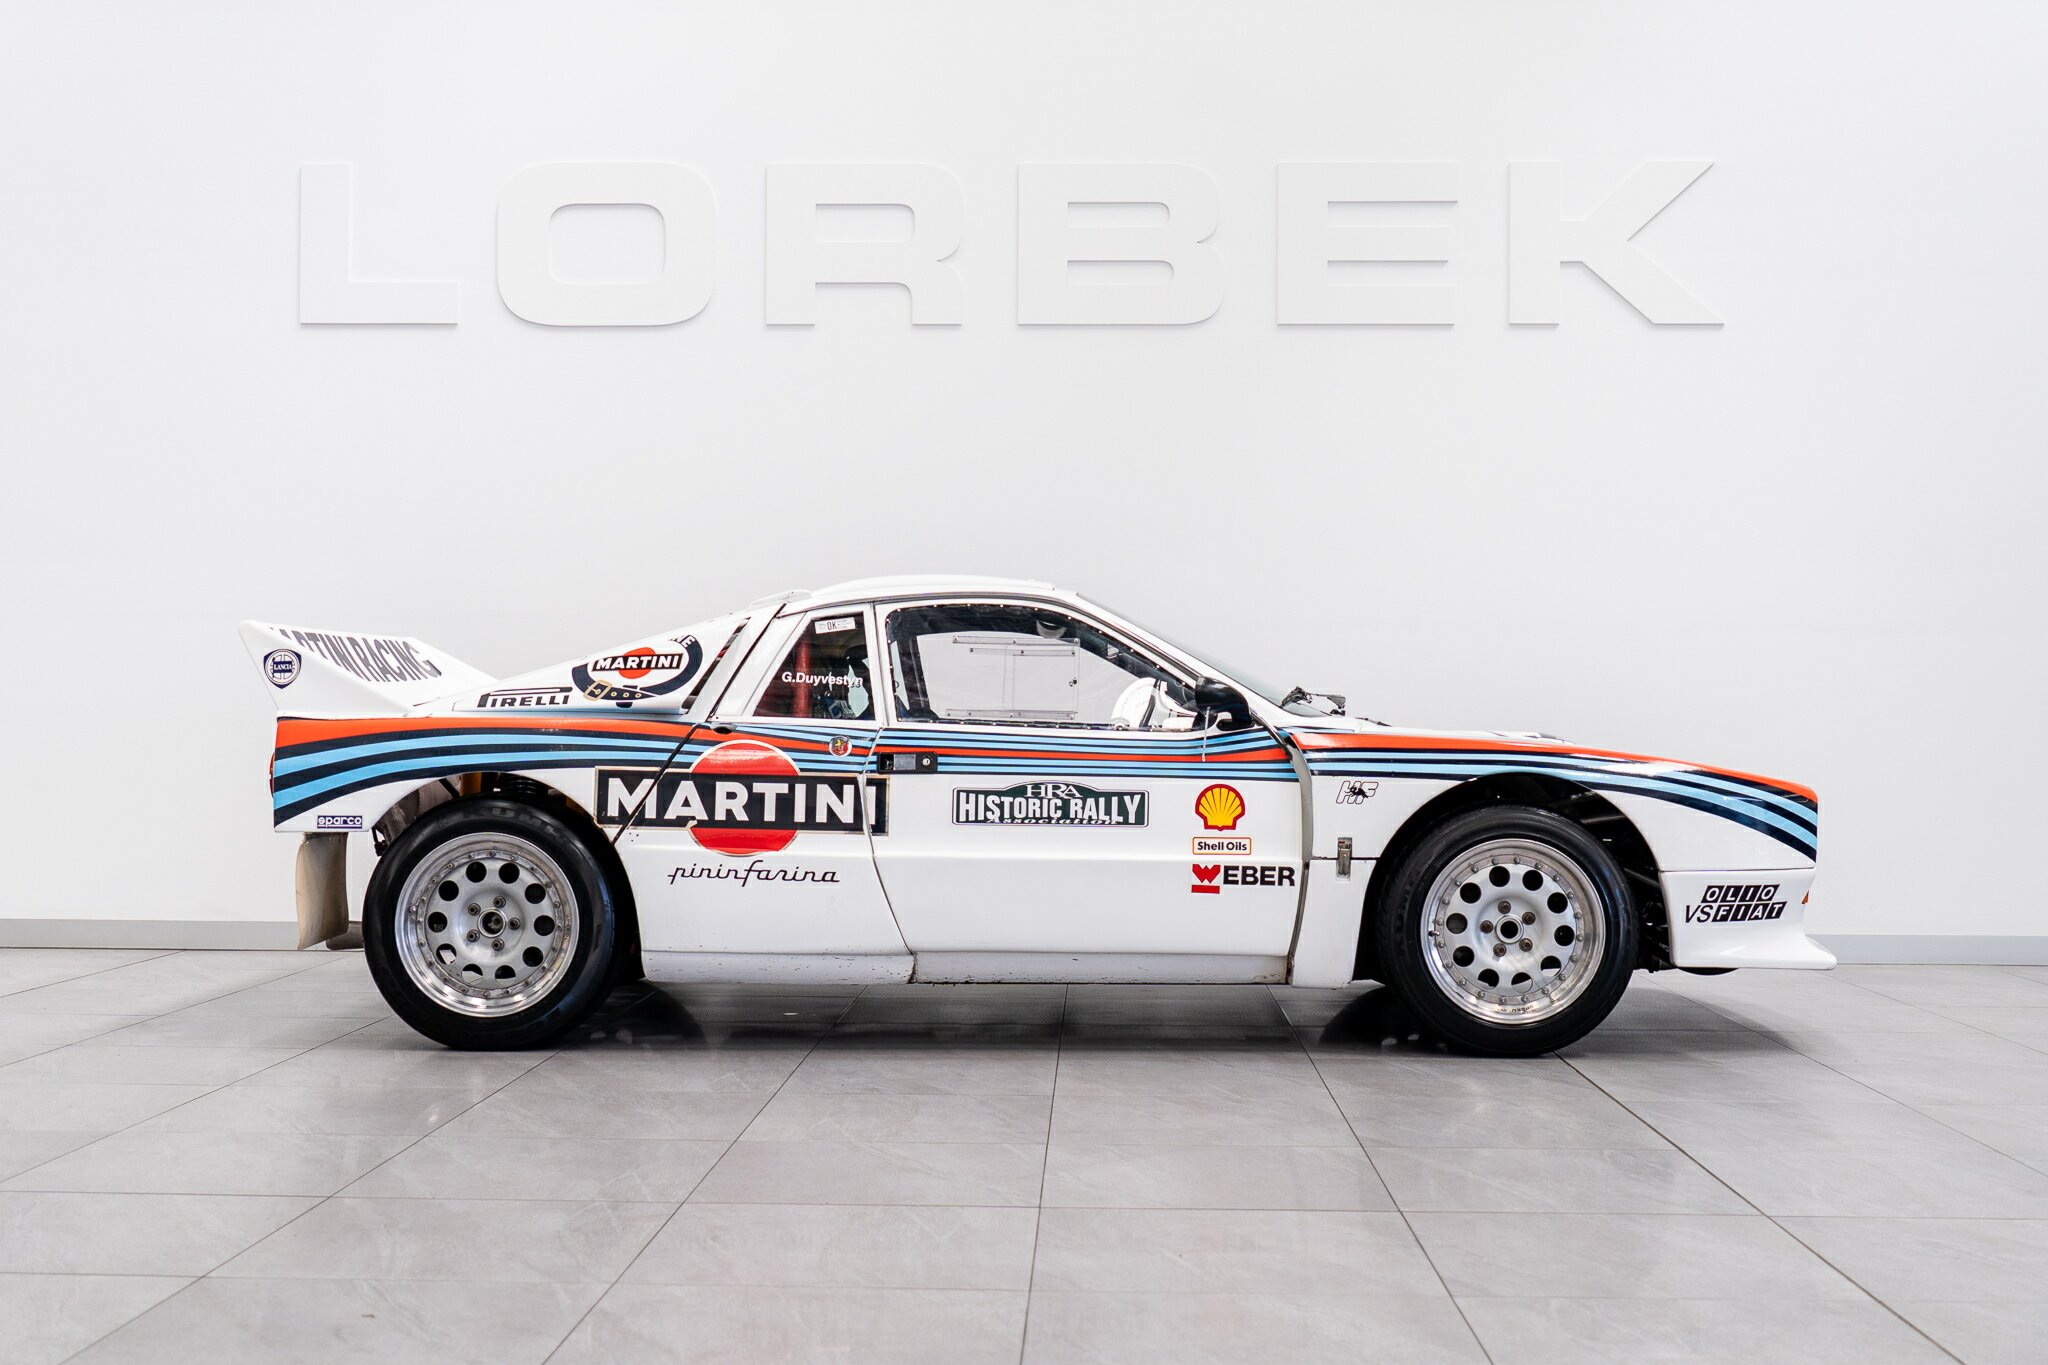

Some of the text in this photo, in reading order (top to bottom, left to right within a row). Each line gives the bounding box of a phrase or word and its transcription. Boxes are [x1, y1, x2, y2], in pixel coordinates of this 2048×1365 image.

[299, 158, 1726, 327] LORBEK
[273, 663, 292, 671] LANCIA
[346, 636, 442, 683] RACING
[595, 655, 680, 670] MARTINI
[781, 671, 864, 688] G.Duyvestyn
[477, 686, 573, 708] PIRELLI
[606, 777, 877, 825] MARTINI
[1024, 783, 1083, 799] HRA
[1336, 780, 1379, 804] HF
[959, 791, 1142, 823] HISTORIC RALLY
[318, 816, 362, 828] sparco
[1197, 841, 1248, 851] Shell Oils
[668, 859, 840, 887] pininfarina
[1191, 863, 1295, 887] WEBER
[1705, 886, 1775, 901] OLIO
